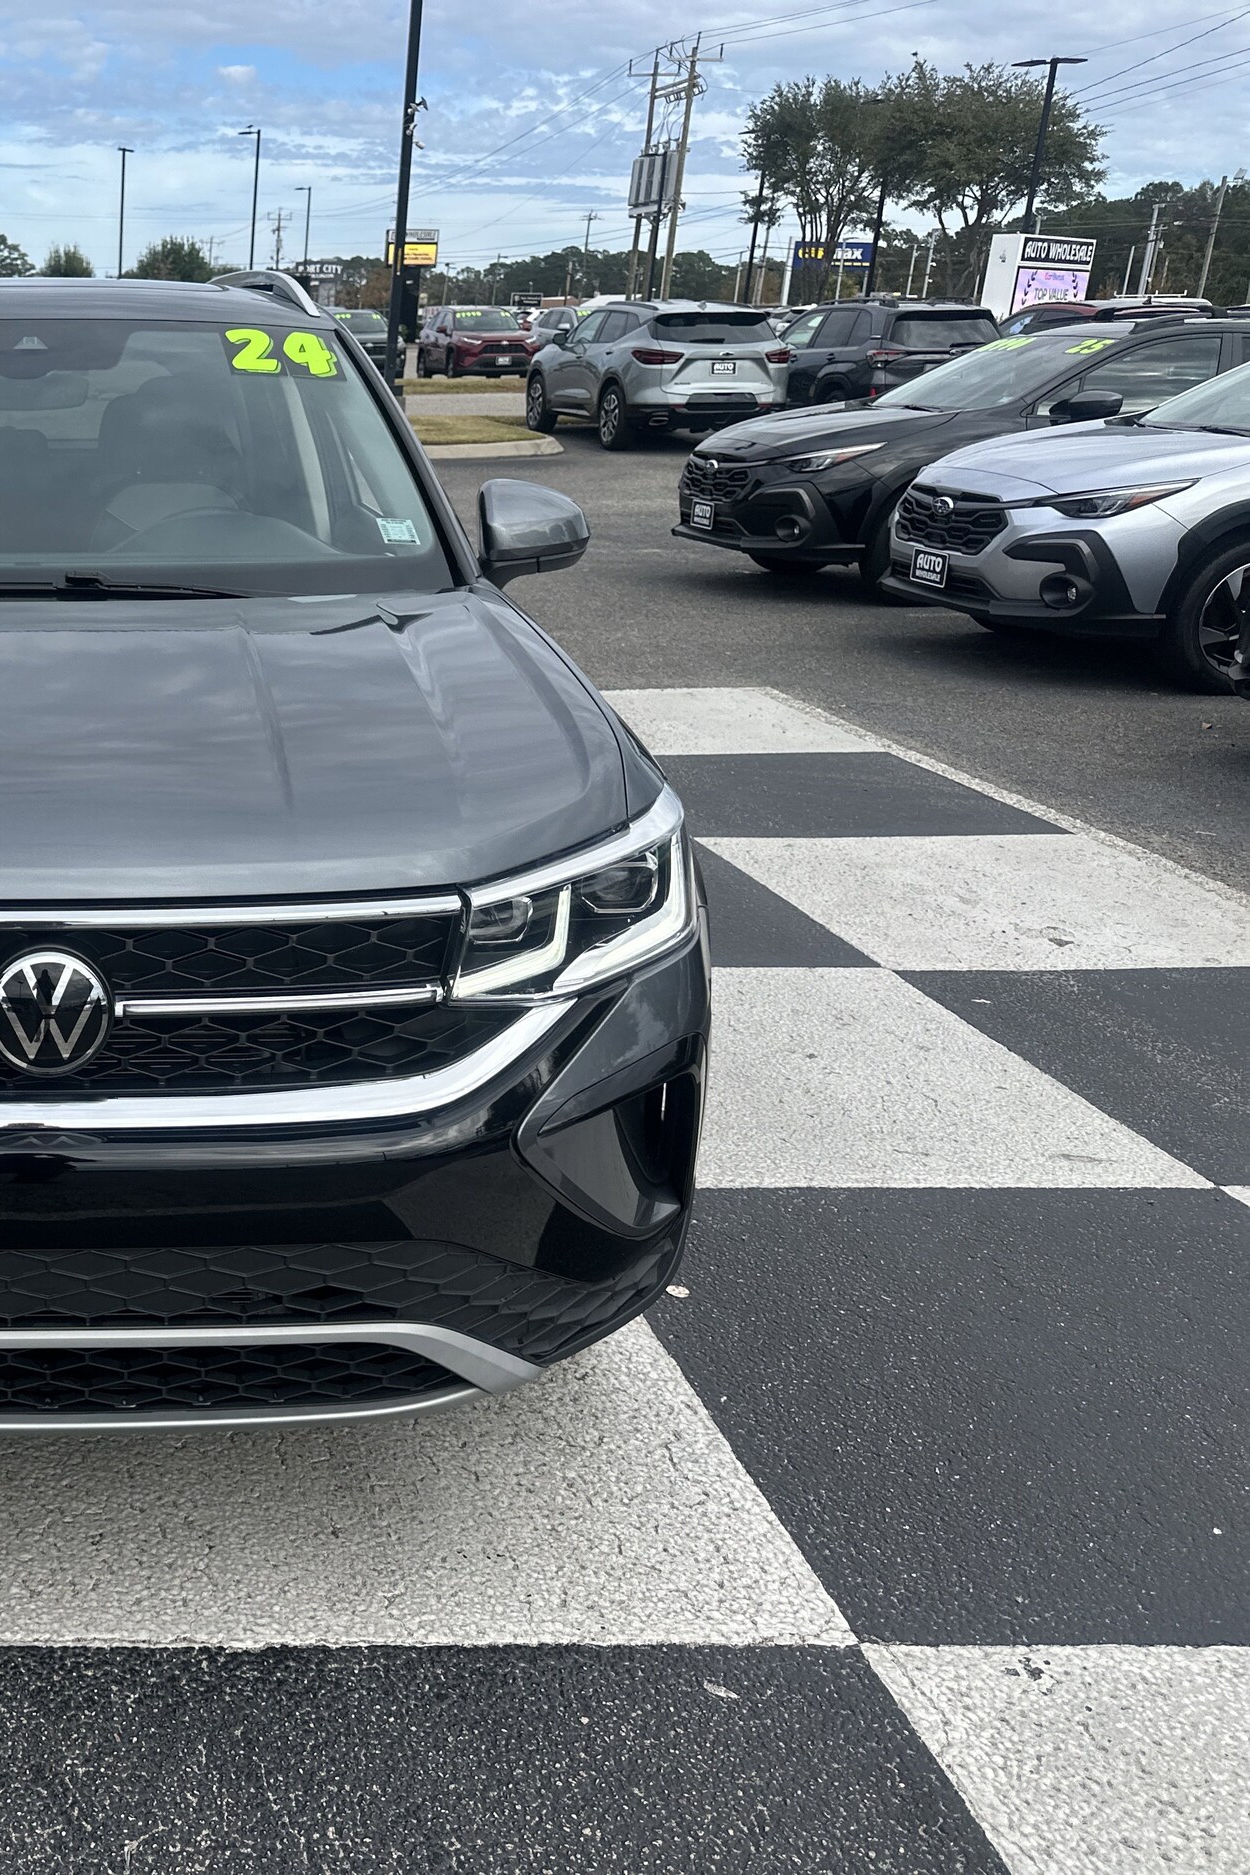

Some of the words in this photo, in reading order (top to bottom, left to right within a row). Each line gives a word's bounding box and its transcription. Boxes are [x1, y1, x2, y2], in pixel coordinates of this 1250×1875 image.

[1024, 241, 1048, 259] AUTO
[1049, 242, 1093, 262] WHOLESALE
[322, 264, 343, 274] CITY
[1034, 287, 1048, 301] TOP
[1048, 288, 1069, 301] VALUE
[224, 328, 338, 378] 24
[1064, 339, 1115, 354] 25
[713, 363, 734, 371] AUTO
[694, 503, 712, 518] AUTO
[916, 553, 943, 573] AUTO
